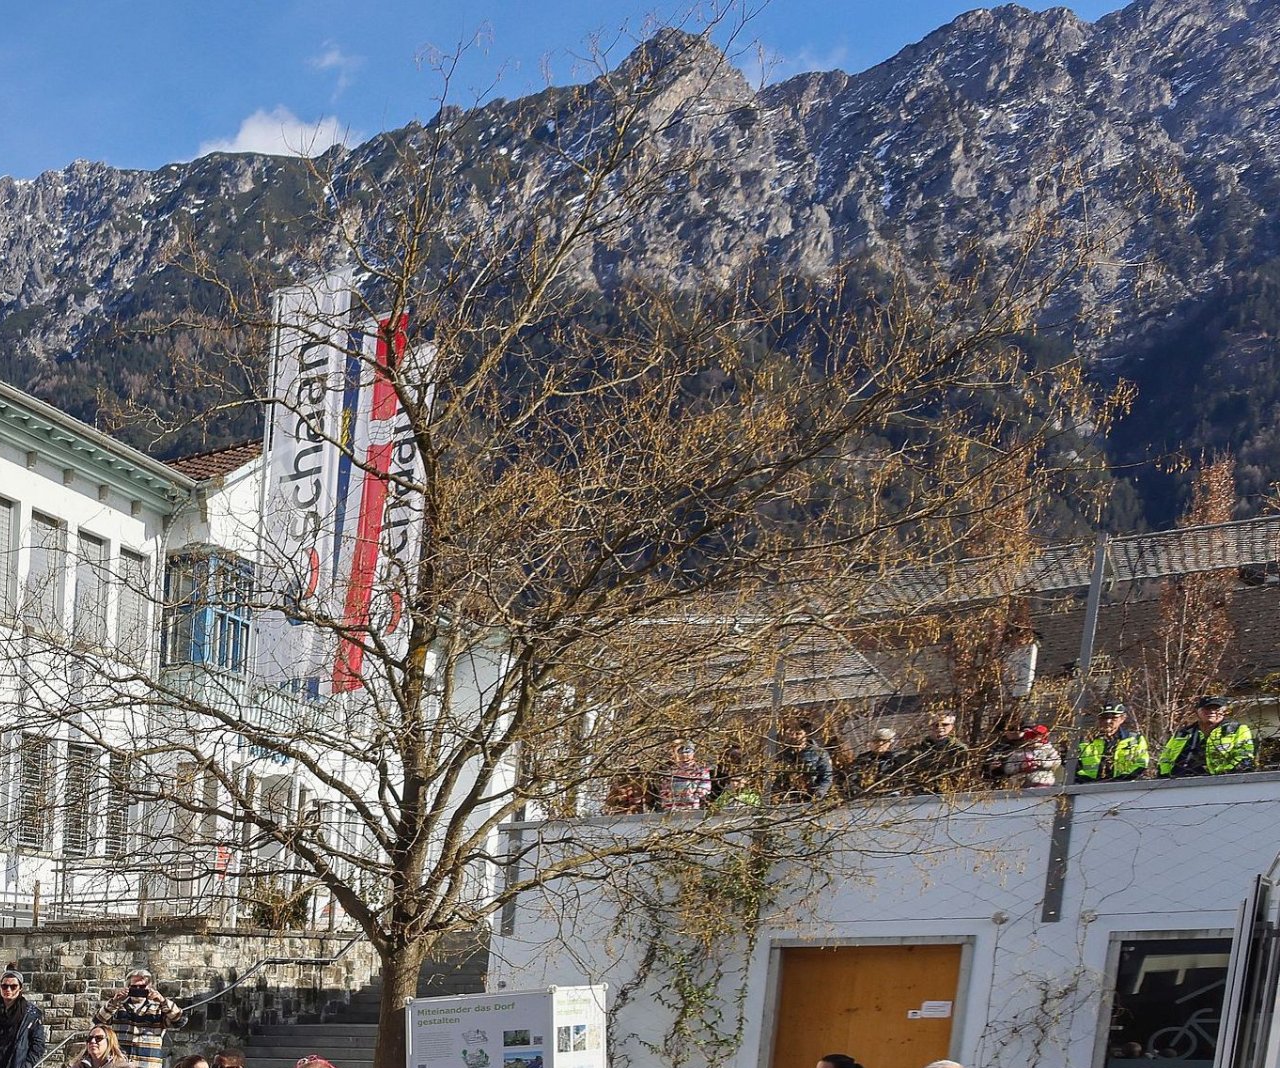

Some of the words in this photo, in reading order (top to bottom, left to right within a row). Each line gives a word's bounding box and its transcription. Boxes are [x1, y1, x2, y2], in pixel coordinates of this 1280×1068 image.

[279, 341, 330, 543] schaan
[417, 1005, 471, 1017] Miteinander
[474, 1004, 491, 1013] das
[494, 1002, 516, 1011] Dorf
[417, 1017, 460, 1027] gestalten
